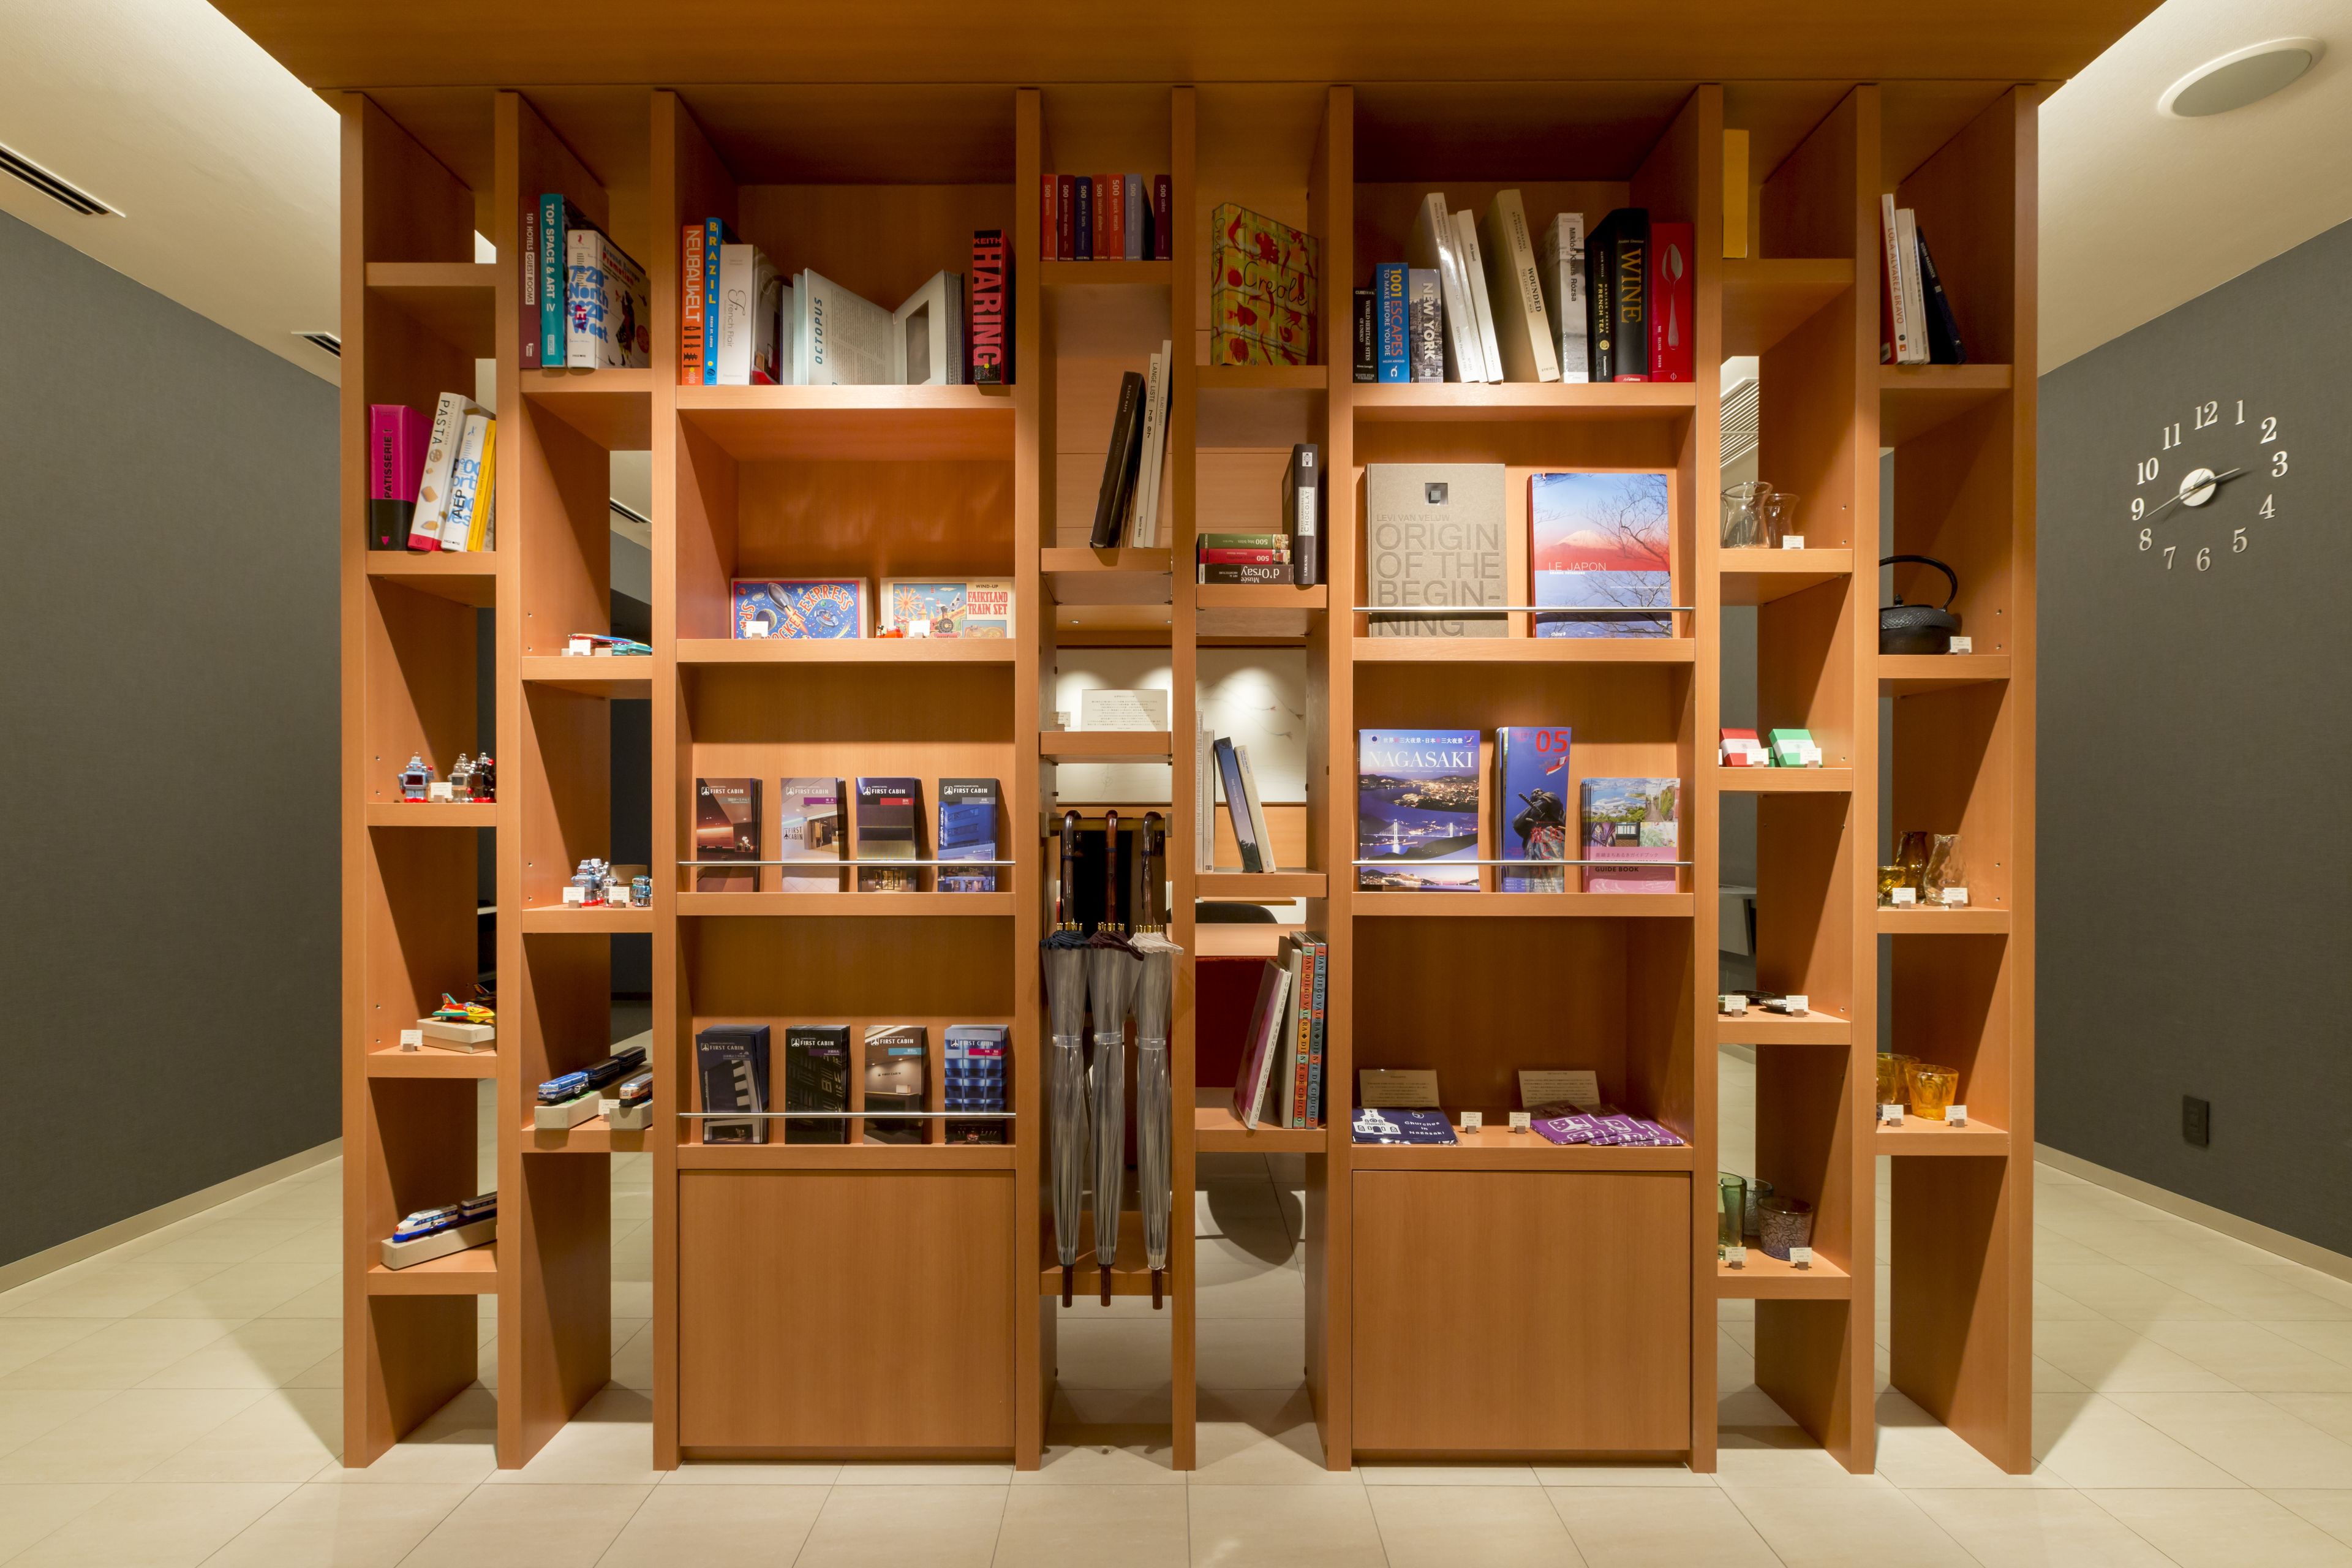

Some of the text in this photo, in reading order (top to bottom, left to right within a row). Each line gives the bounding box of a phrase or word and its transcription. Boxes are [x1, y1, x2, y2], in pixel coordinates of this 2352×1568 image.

[545, 203, 555, 298] TOP SPACE & ART
[708, 222, 718, 304] BRAZIL
[685, 230, 701, 322] NEUBAUWELT
[1243, 261, 1308, 306] Creole
[1384, 269, 1390, 278] TO
[1621, 249, 1642, 323] WINE
[1888, 227, 1904, 324] LOLA ALVAREZ BRAVO
[1528, 268, 1541, 312] WOUNDED
[575, 304, 586, 331] AEP
[728, 289, 747, 329] French
[973, 245, 1002, 367] HARING
[1390, 269, 1403, 356] 1001 ESCAPES
[814, 297, 823, 364] OCTOPUS
[1423, 282, 1435, 360] NEW YORK
[432, 399, 450, 444] PASTA
[2195, 401, 2218, 430] 12
[2235, 400, 2245, 425] 1
[2163, 423, 2182, 450] 11
[2260, 417, 2277, 444] 2
[2137, 458, 2159, 485] 10
[2272, 451, 2288, 477] 3
[452, 489, 466, 519] AEP
[2131, 497, 2144, 521] 9
[2259, 494, 2276, 519] 4
[1376, 524, 1498, 551] ORIGIN
[2139, 528, 2152, 551] 8
[2233, 527, 2247, 553] 5
[1376, 552, 1499, 579] OF THE
[1548, 562, 1607, 571] LE JAPON
[2163, 546, 2176, 570] 7
[2196, 548, 2211, 571] 6
[1241, 566, 1280, 579] d'Orsay
[797, 584, 854, 616] EXPRESS
[967, 591, 1008, 603] FAIRYLAND
[1378, 581, 1500, 608] BEGIN-
[967, 603, 1008, 615] TRAIN SET
[1378, 611, 1464, 636] NING
[1536, 730, 1569, 752] 05
[1368, 751, 1474, 768] NAGASAKI
[788, 826, 802, 835] FIRST
[1268, 1022, 1280, 1060] MARNIX
[1298, 1073, 1305, 1085] DE
[1311, 1074, 1317, 1085] DE
[1254, 1068, 1269, 1120] GOOSSENS
[1309, 1087, 1317, 1123] CHUCHO
